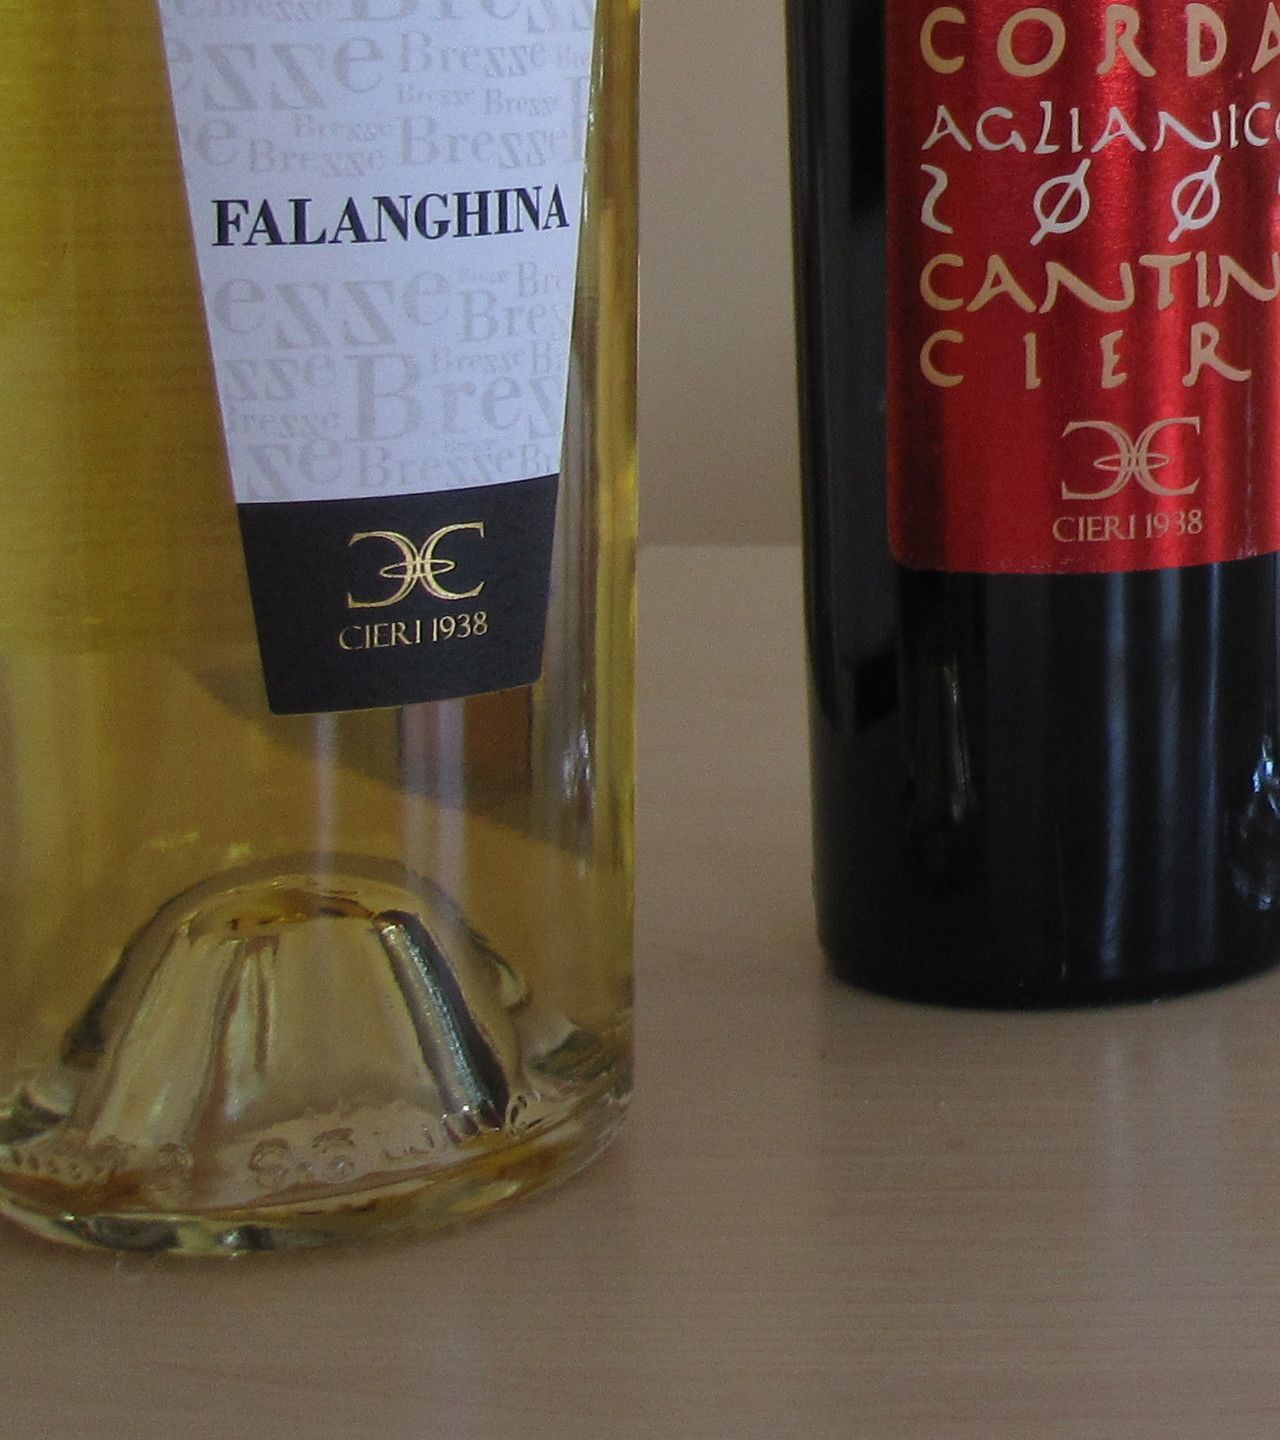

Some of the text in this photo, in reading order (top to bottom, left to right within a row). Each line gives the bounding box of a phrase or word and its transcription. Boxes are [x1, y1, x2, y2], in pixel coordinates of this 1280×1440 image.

[211, 183, 571, 247] FALANGHINA
[1052, 509, 1204, 544] CIERI 1938
[338, 611, 489, 652] CIERI 1938
